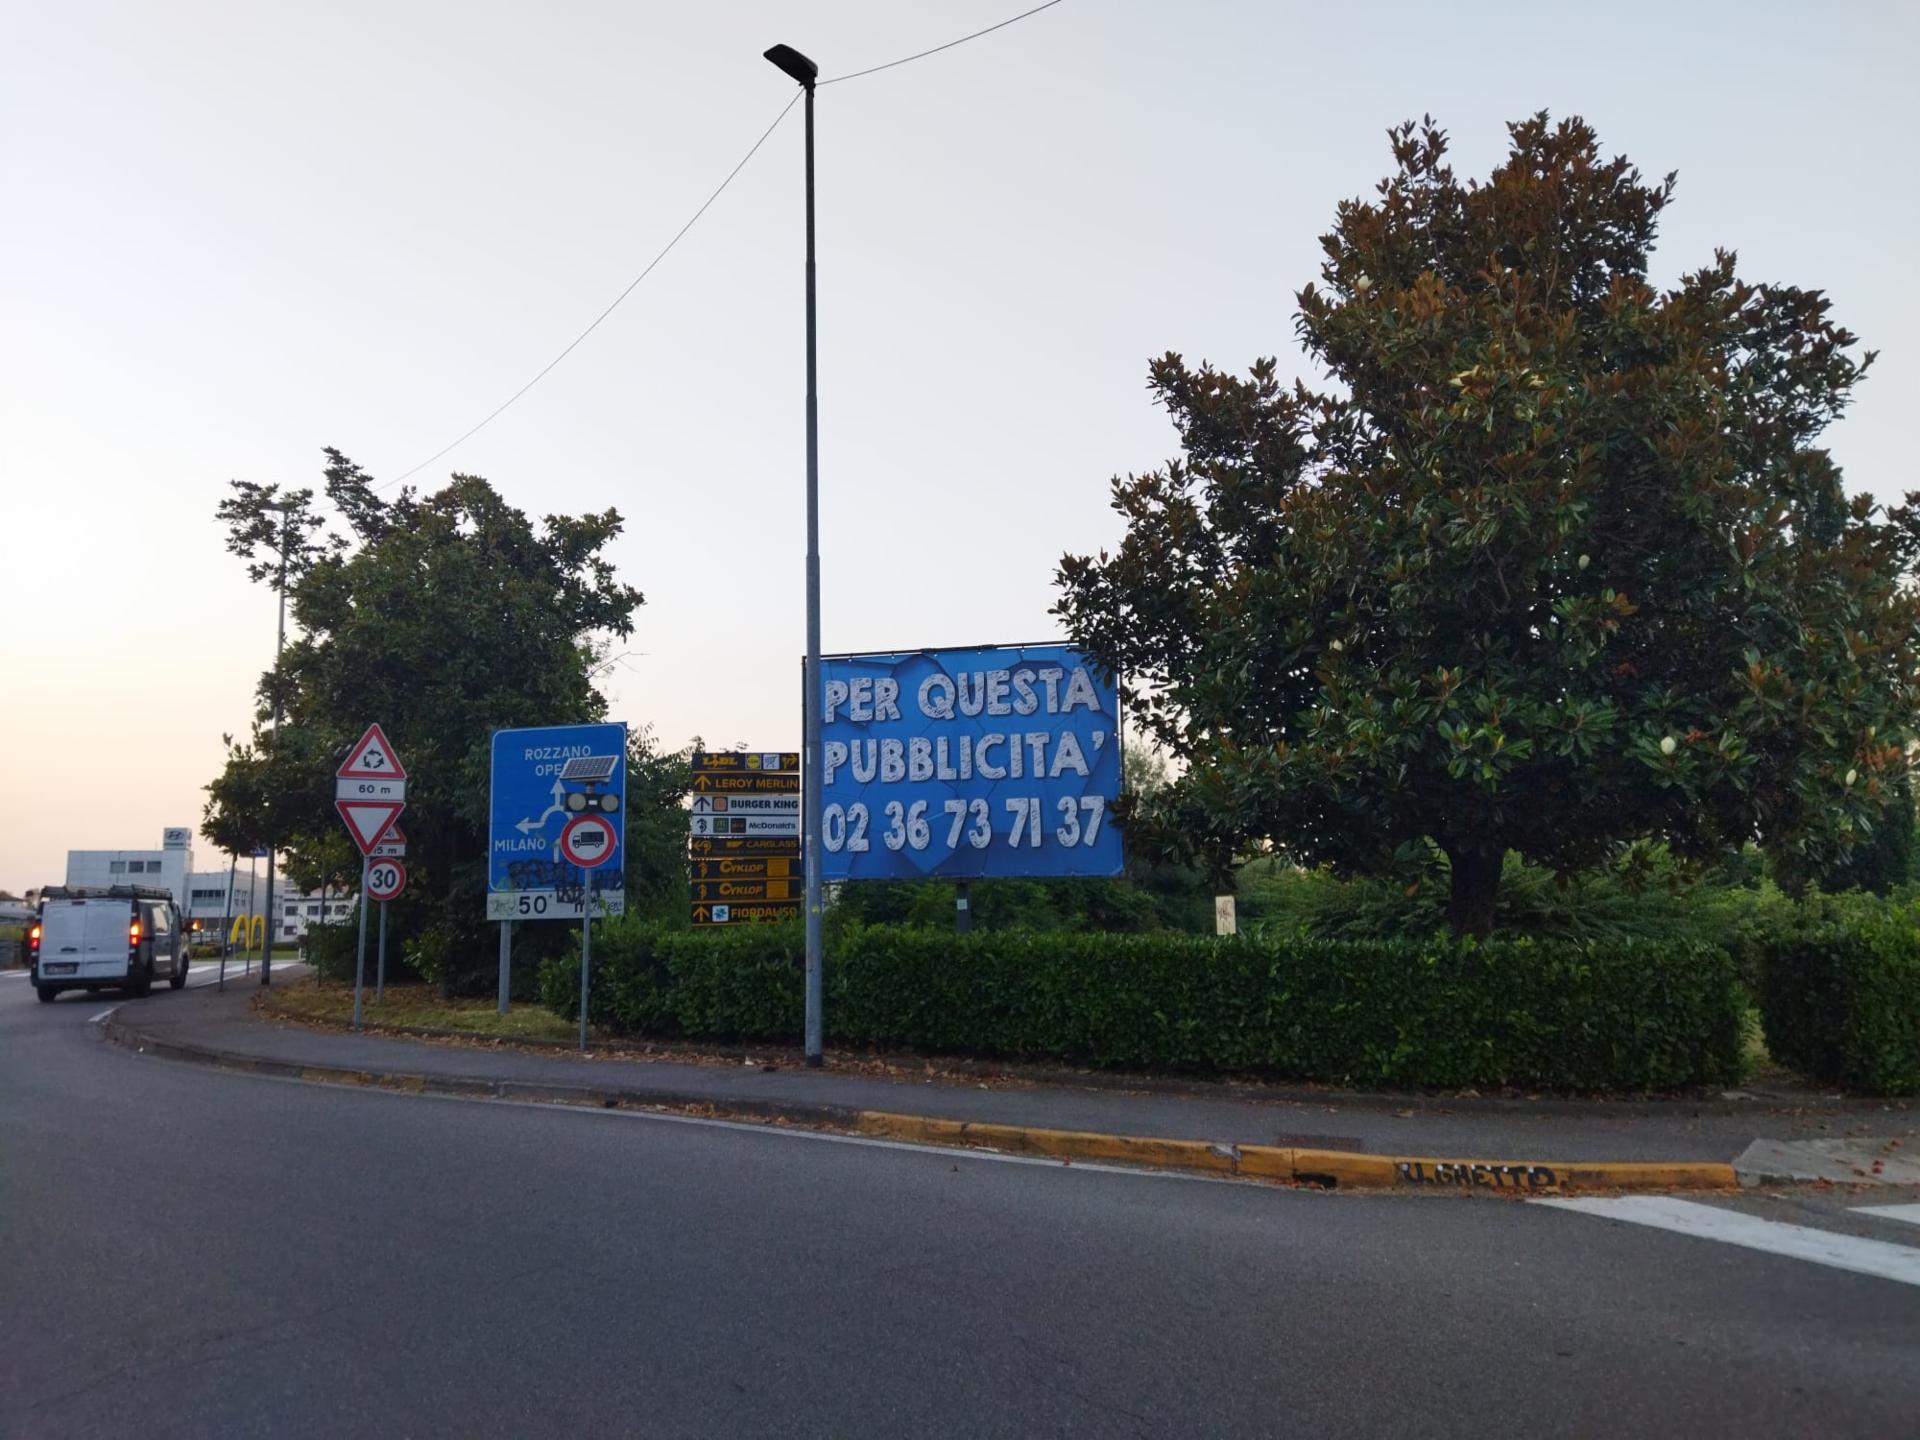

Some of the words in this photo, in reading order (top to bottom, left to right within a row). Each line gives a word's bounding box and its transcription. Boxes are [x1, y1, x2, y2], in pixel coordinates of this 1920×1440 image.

[823, 676, 901, 724] PER
[917, 666, 1101, 721] QUESTA
[525, 745, 591, 761] ROZZANO
[823, 729, 1106, 786] PUBBLICITA'
[359, 785, 375, 794] 60
[381, 786, 391, 794] m
[715, 779, 754, 788] LEROY
[756, 779, 798, 788] MERLIN
[730, 800, 772, 809] BURGER
[773, 800, 799, 809] KING
[749, 821, 796, 829] McDonald's
[821, 802, 871, 853] 02
[883, 800, 930, 851] 36
[944, 798, 992, 849] 73
[1005, 797, 1042, 848] 71
[1056, 795, 1104, 847] 37
[494, 838, 546, 852] MILANO
[746, 840, 797, 848] CARGLASS
[372, 869, 396, 889] 30
[519, 895, 547, 914] 50
